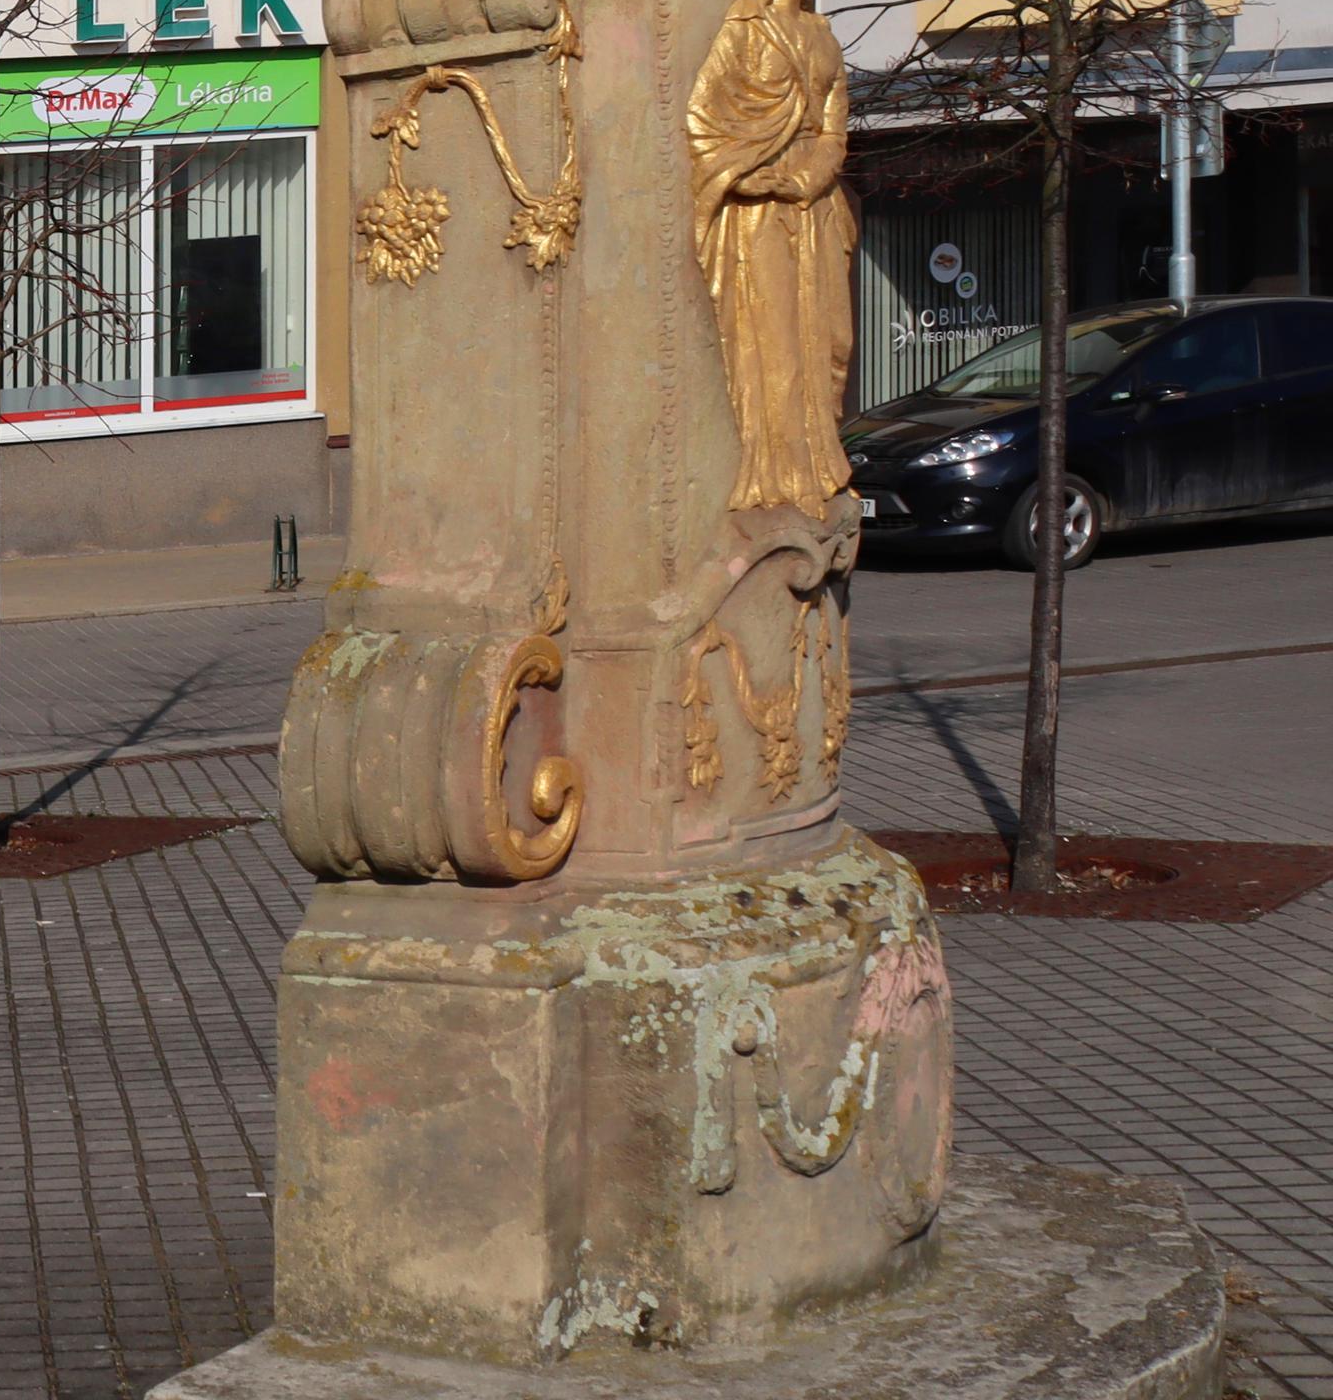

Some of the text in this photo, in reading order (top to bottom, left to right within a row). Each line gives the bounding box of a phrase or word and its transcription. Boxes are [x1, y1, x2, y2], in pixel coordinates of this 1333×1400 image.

[47, 81, 272, 112] Dr.Max Lékárna
[920, 304, 998, 328] OBILKA
[922, 327, 988, 343] REGIONÁLNÍ
